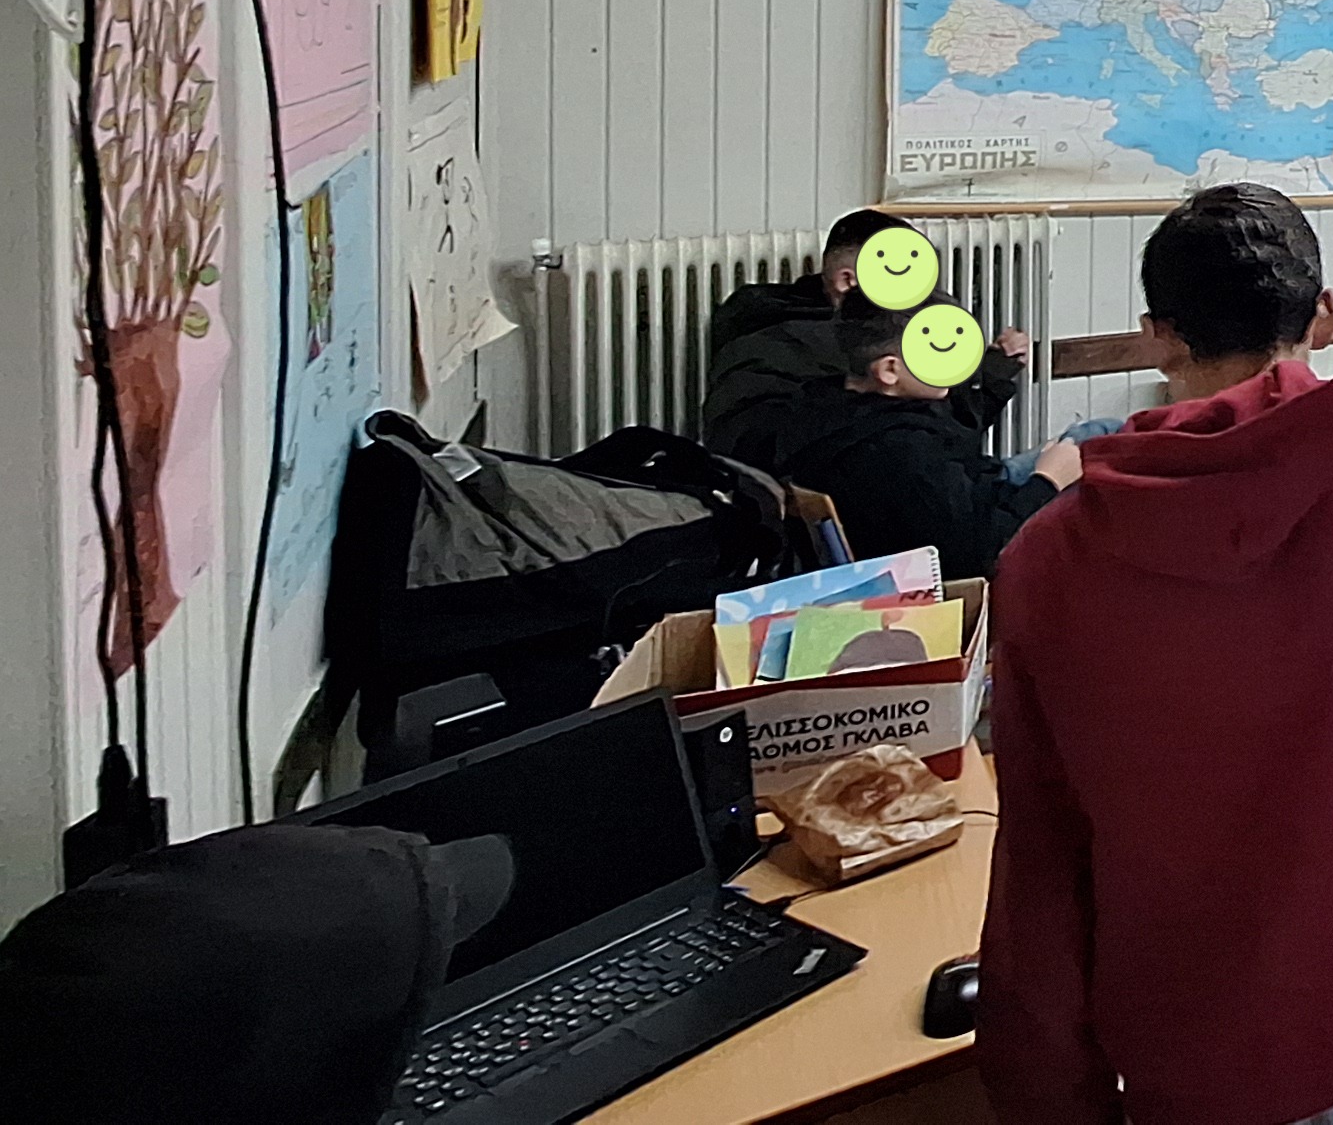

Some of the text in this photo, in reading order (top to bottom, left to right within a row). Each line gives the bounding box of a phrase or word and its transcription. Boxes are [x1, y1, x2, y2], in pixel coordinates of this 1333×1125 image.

[905, 137, 1030, 150] ΠΟΛΙΤΙΚΟΣ ΧΑΡΤΗΣ
[899, 150, 1038, 173] ΕΥΡΩΠΗΣ
[748, 699, 931, 742] ΕΛΙΣΣΟΚΟΜΙΚΟ
[750, 720, 930, 761] ΑΘΜΟΣ ΓΚΛΑΒΑ
